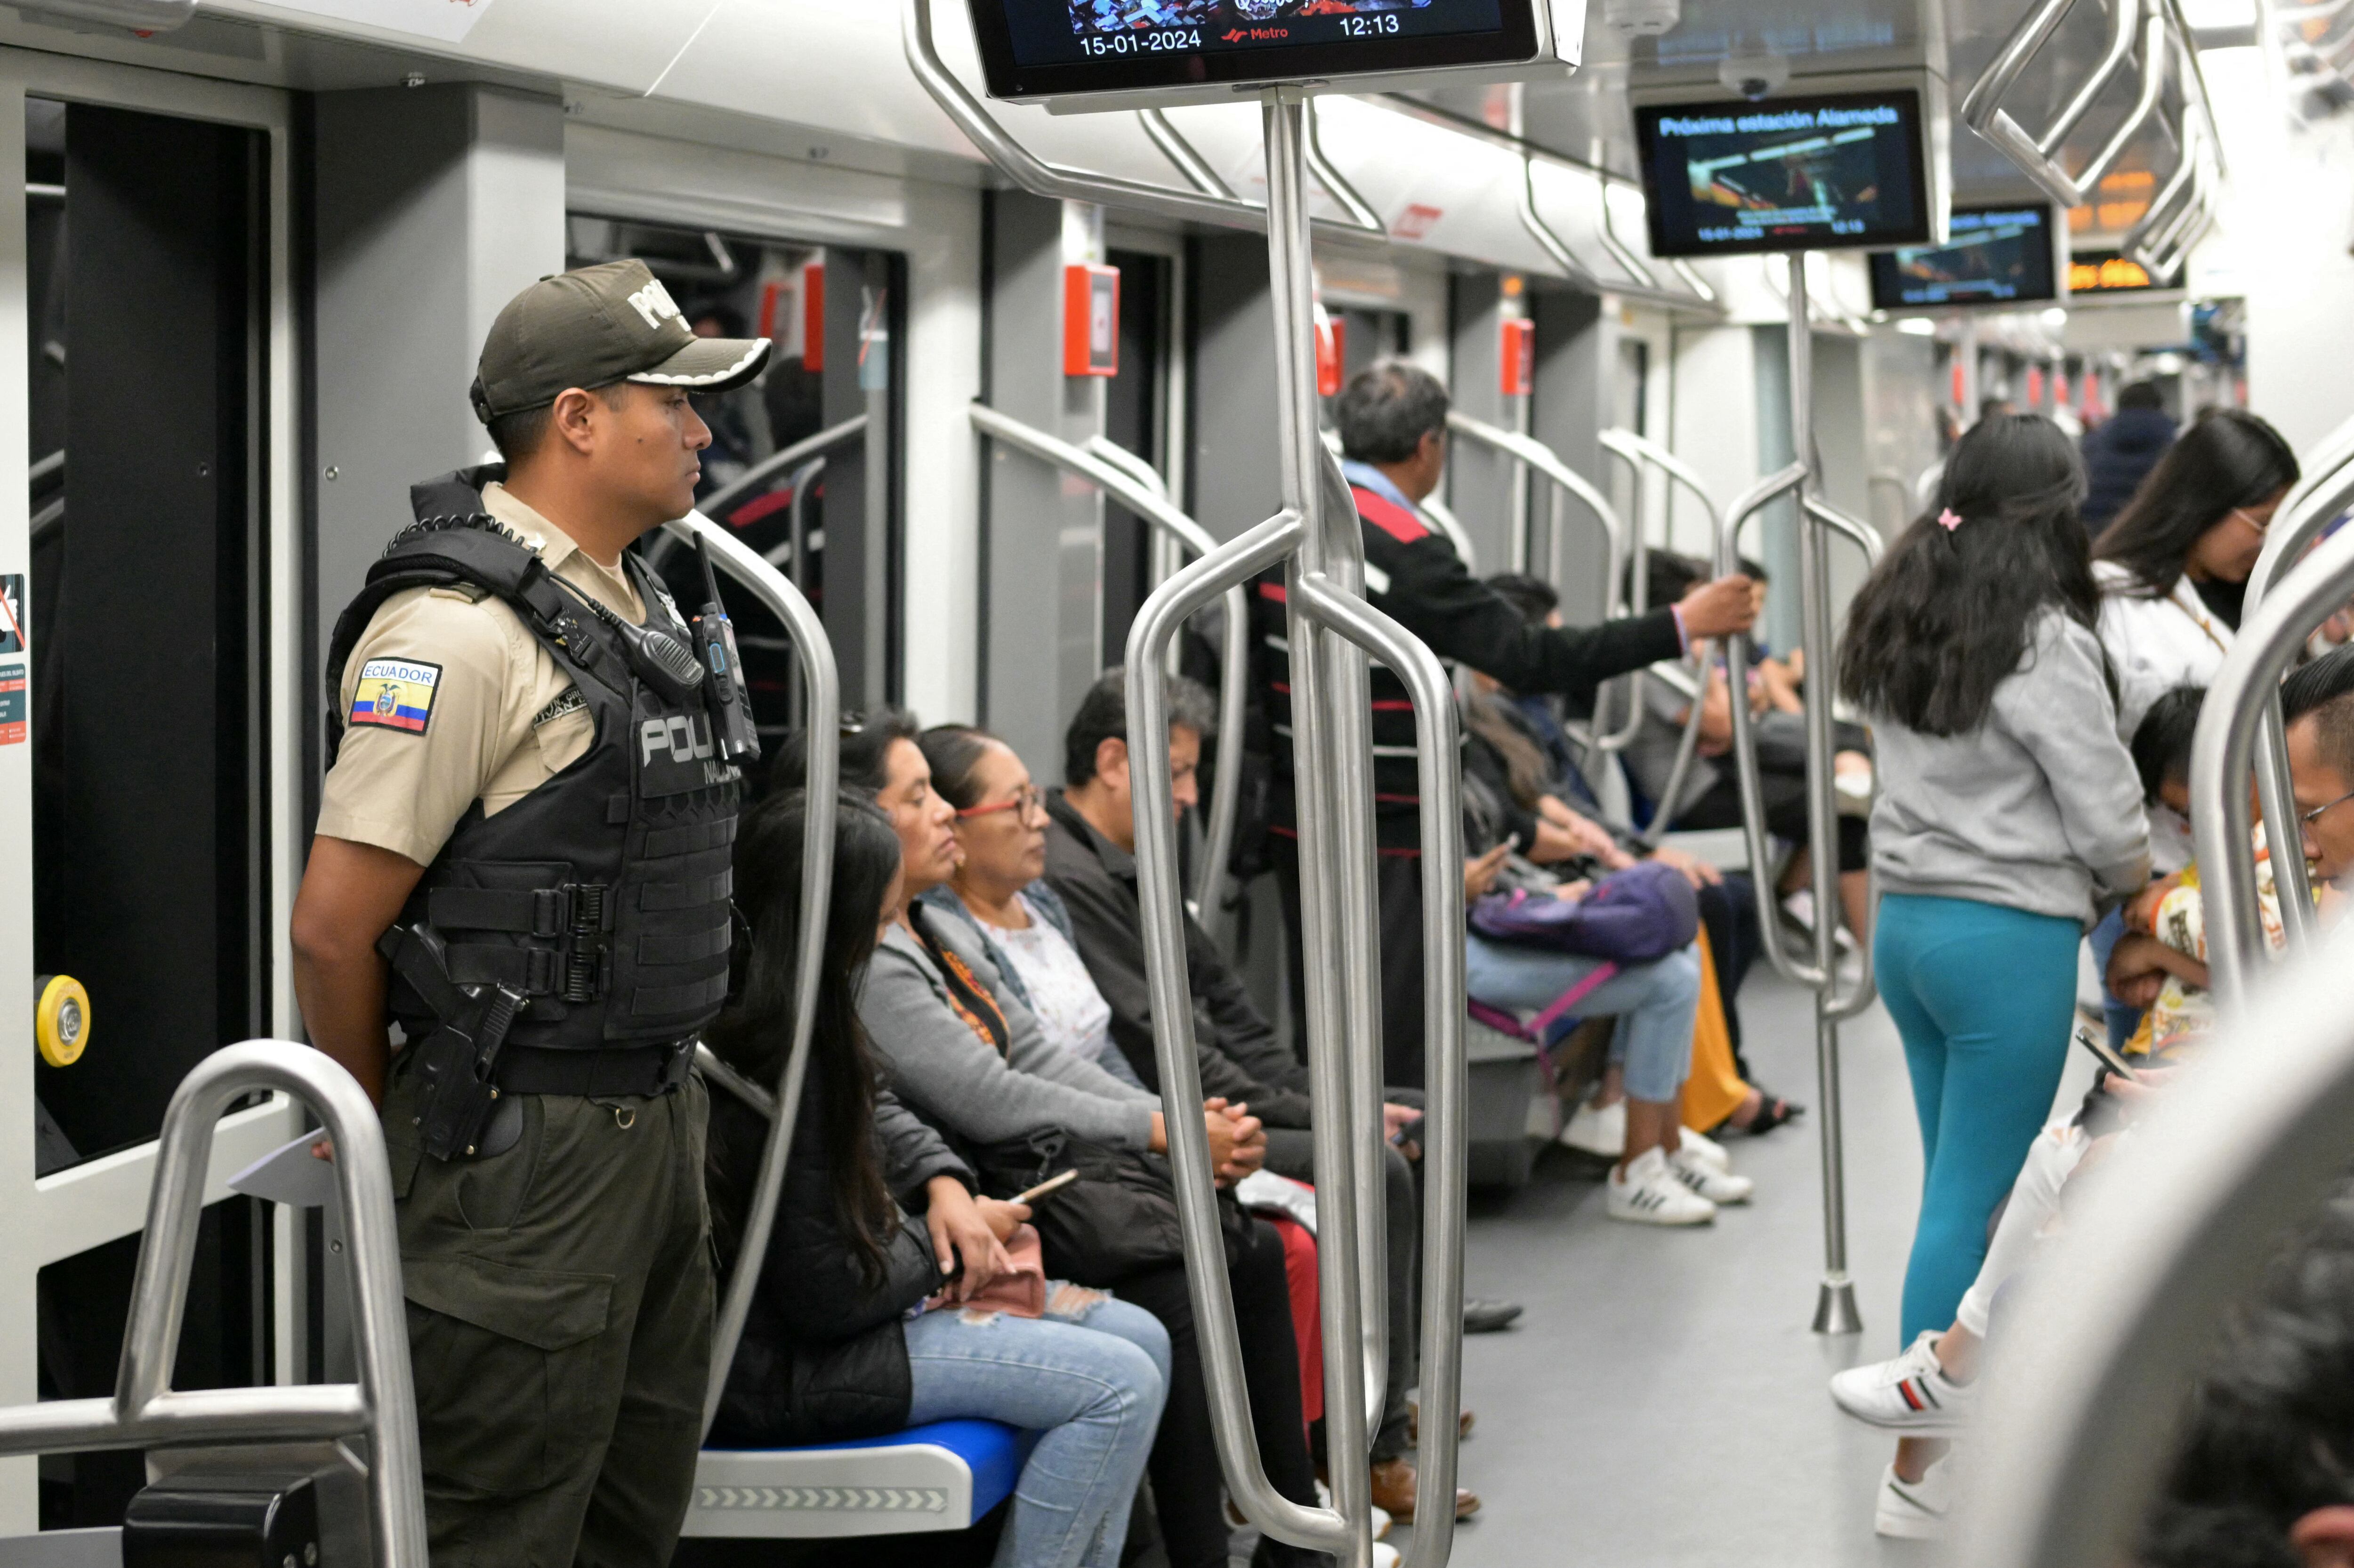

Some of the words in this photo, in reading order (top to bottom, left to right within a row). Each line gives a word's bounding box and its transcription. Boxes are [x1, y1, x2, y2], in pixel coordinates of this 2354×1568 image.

[1250, 27, 1288, 40] Metro
[1339, 14, 1399, 36] 12:13
[1080, 29, 1201, 56] 15-01-2024
[1659, 116, 1735, 137] Próxima
[1736, 111, 1815, 133] estación
[1816, 105, 1898, 127] Alameda
[364, 665, 433, 683] ECUADOR
